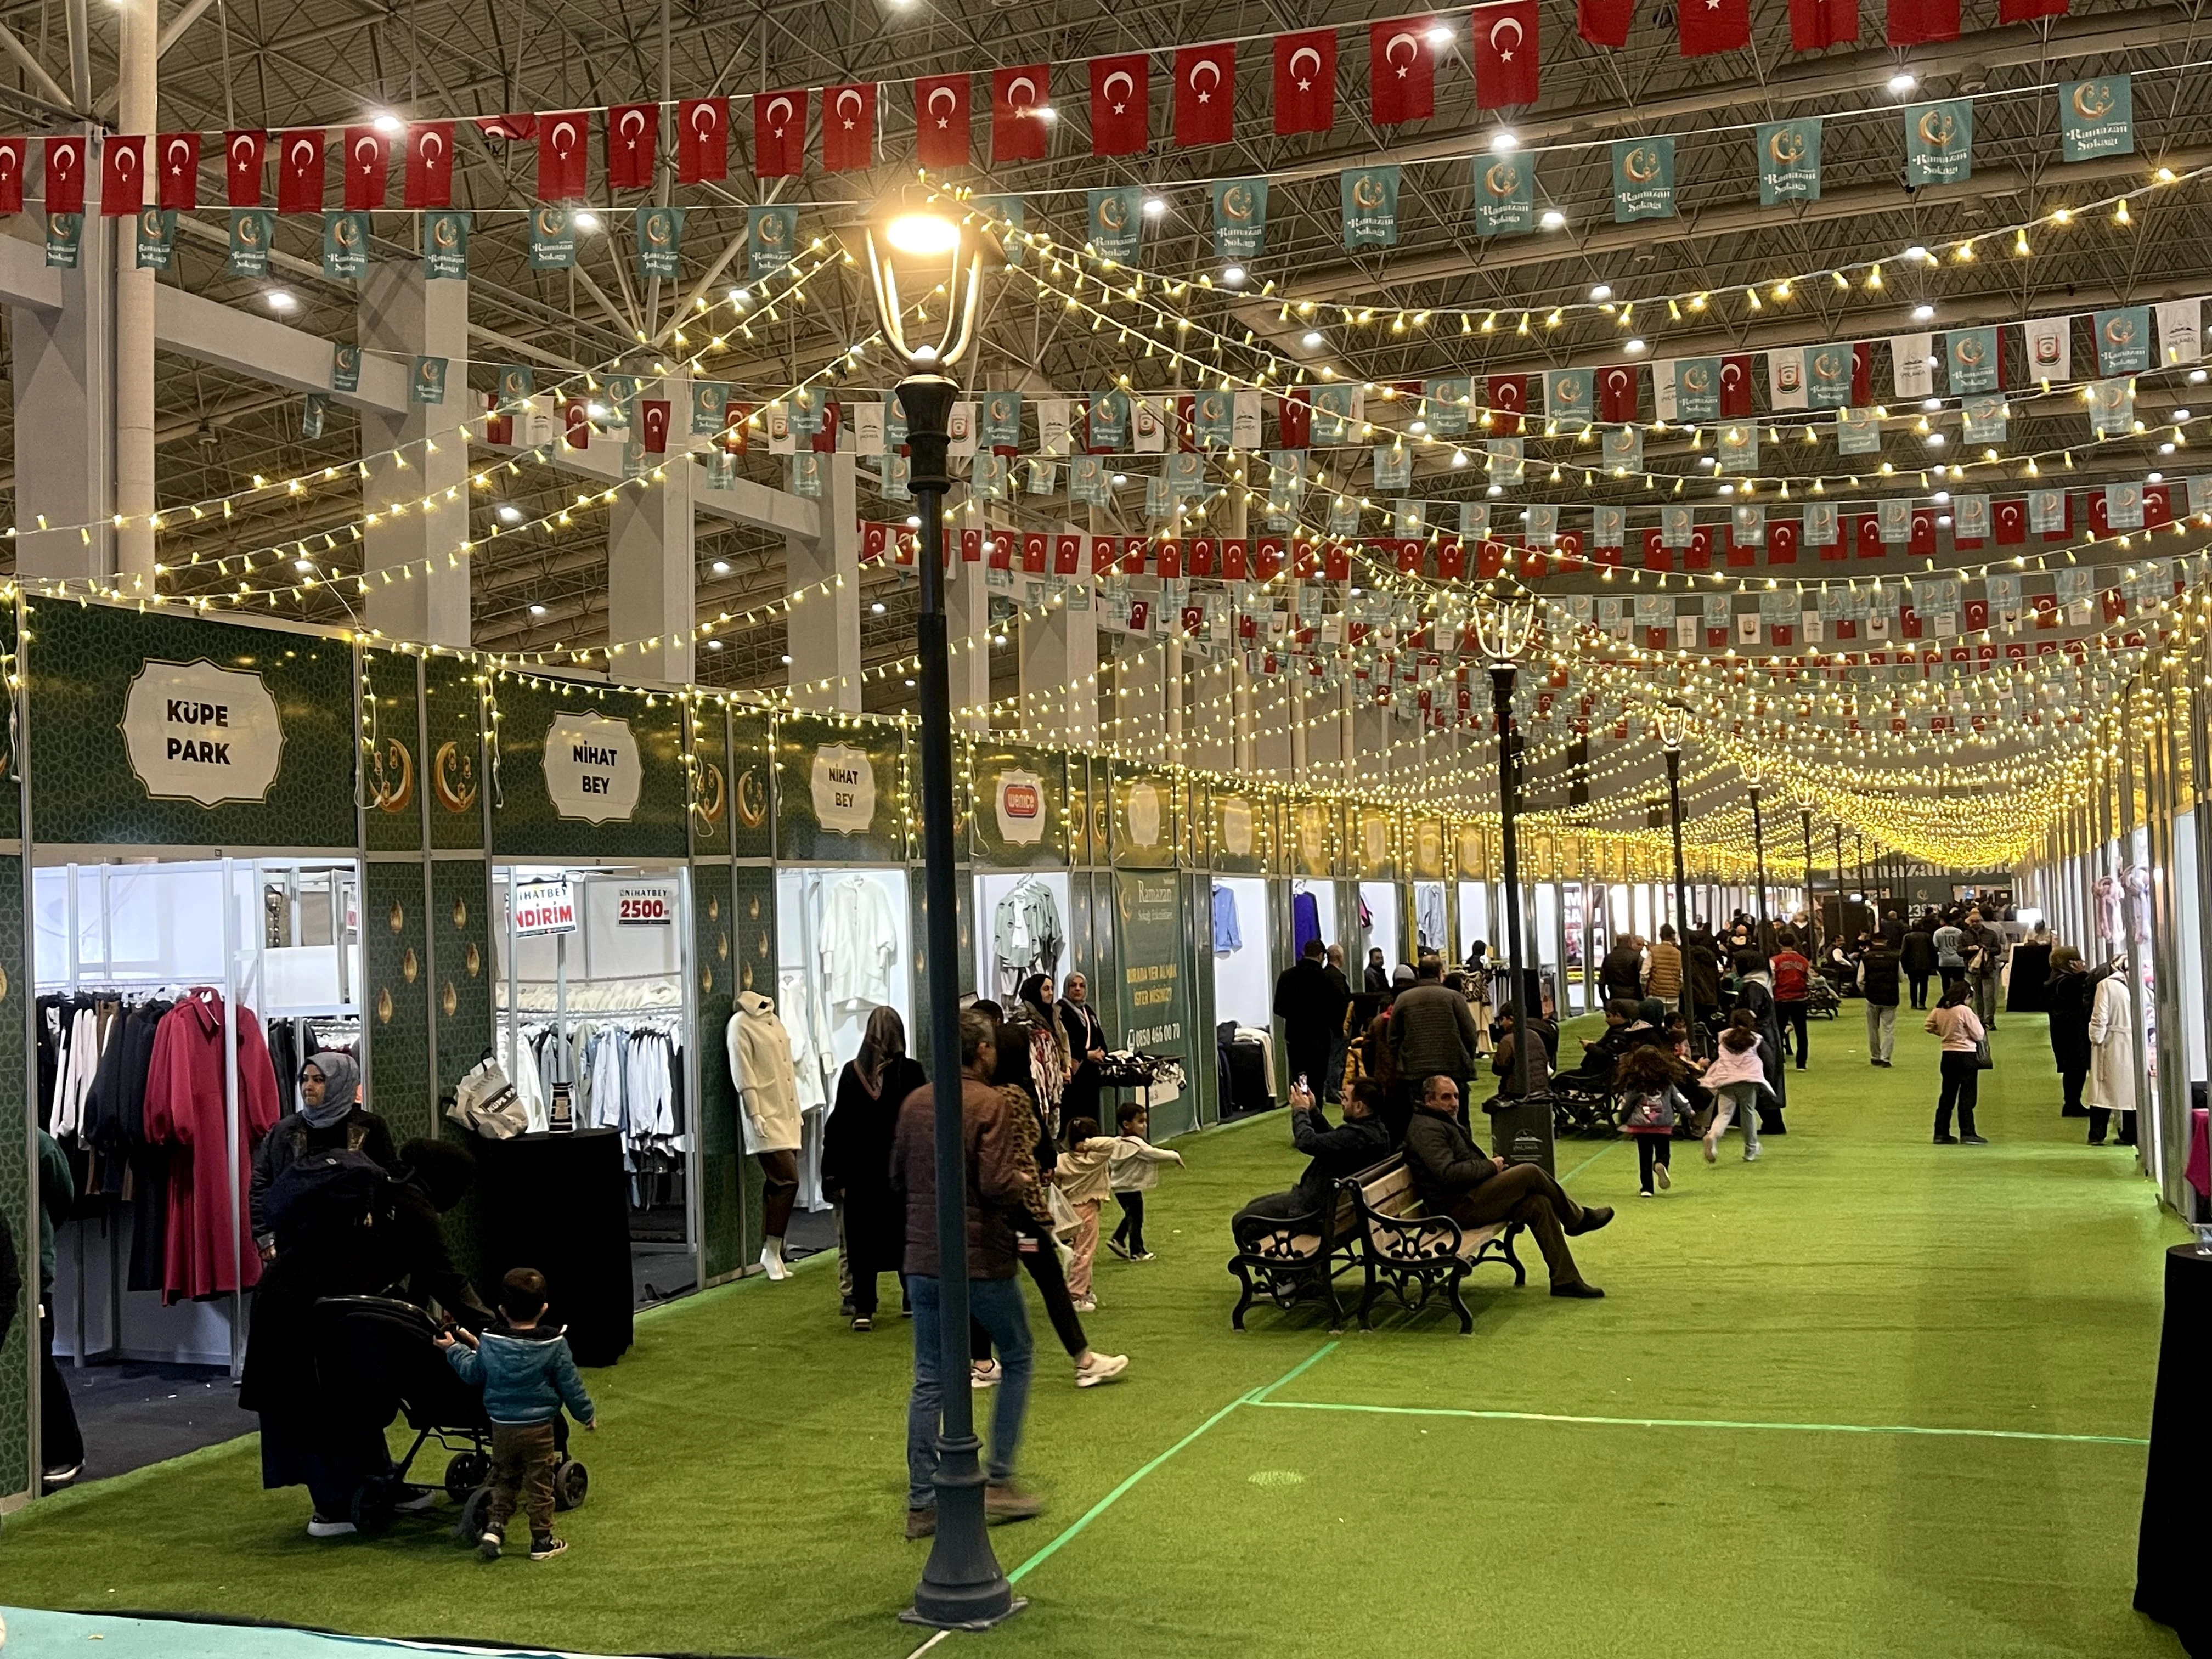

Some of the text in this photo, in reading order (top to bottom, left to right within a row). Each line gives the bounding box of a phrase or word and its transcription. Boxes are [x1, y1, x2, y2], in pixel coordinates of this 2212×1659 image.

[167, 699, 229, 728] KÜPE
[167, 737, 231, 765] PARK
[573, 740, 618, 767] NİHAT
[582, 775, 610, 794] BEY
[828, 763, 858, 785] NİHAT
[835, 792, 854, 808] BEY
[517, 888, 567, 901] İHATBEY
[1137, 879, 1172, 903] Ramazan
[620, 899, 663, 918] 2500
